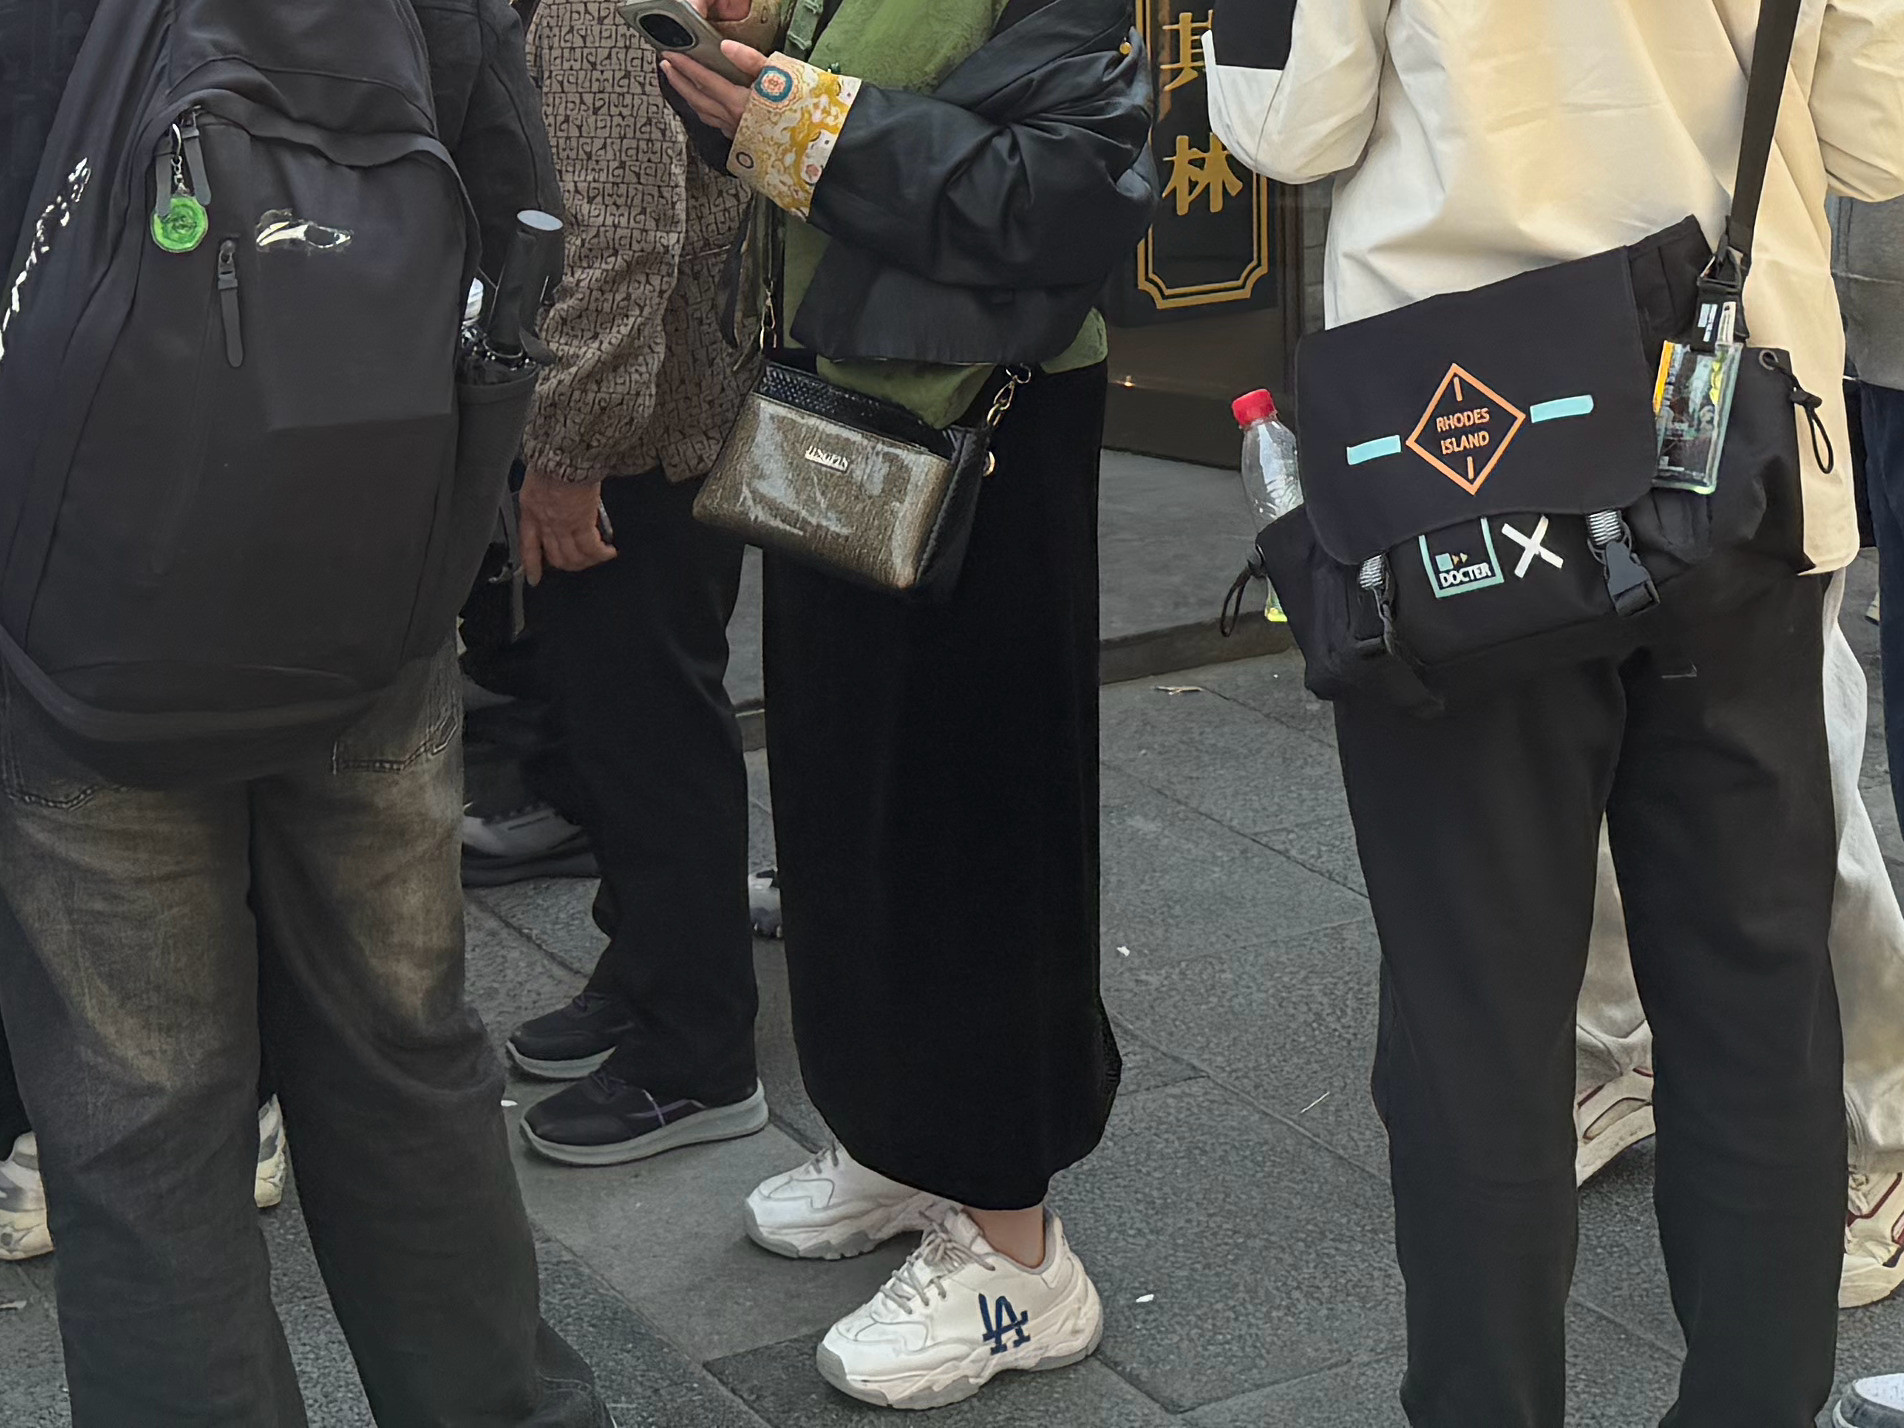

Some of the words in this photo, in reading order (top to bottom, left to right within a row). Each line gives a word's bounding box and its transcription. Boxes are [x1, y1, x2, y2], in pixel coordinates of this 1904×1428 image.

[1435, 407, 1491, 433] RHODES
[1440, 430, 1491, 455] ISLAND
[1439, 561, 1493, 587] DOCTER
[978, 1292, 1032, 1355] LA
